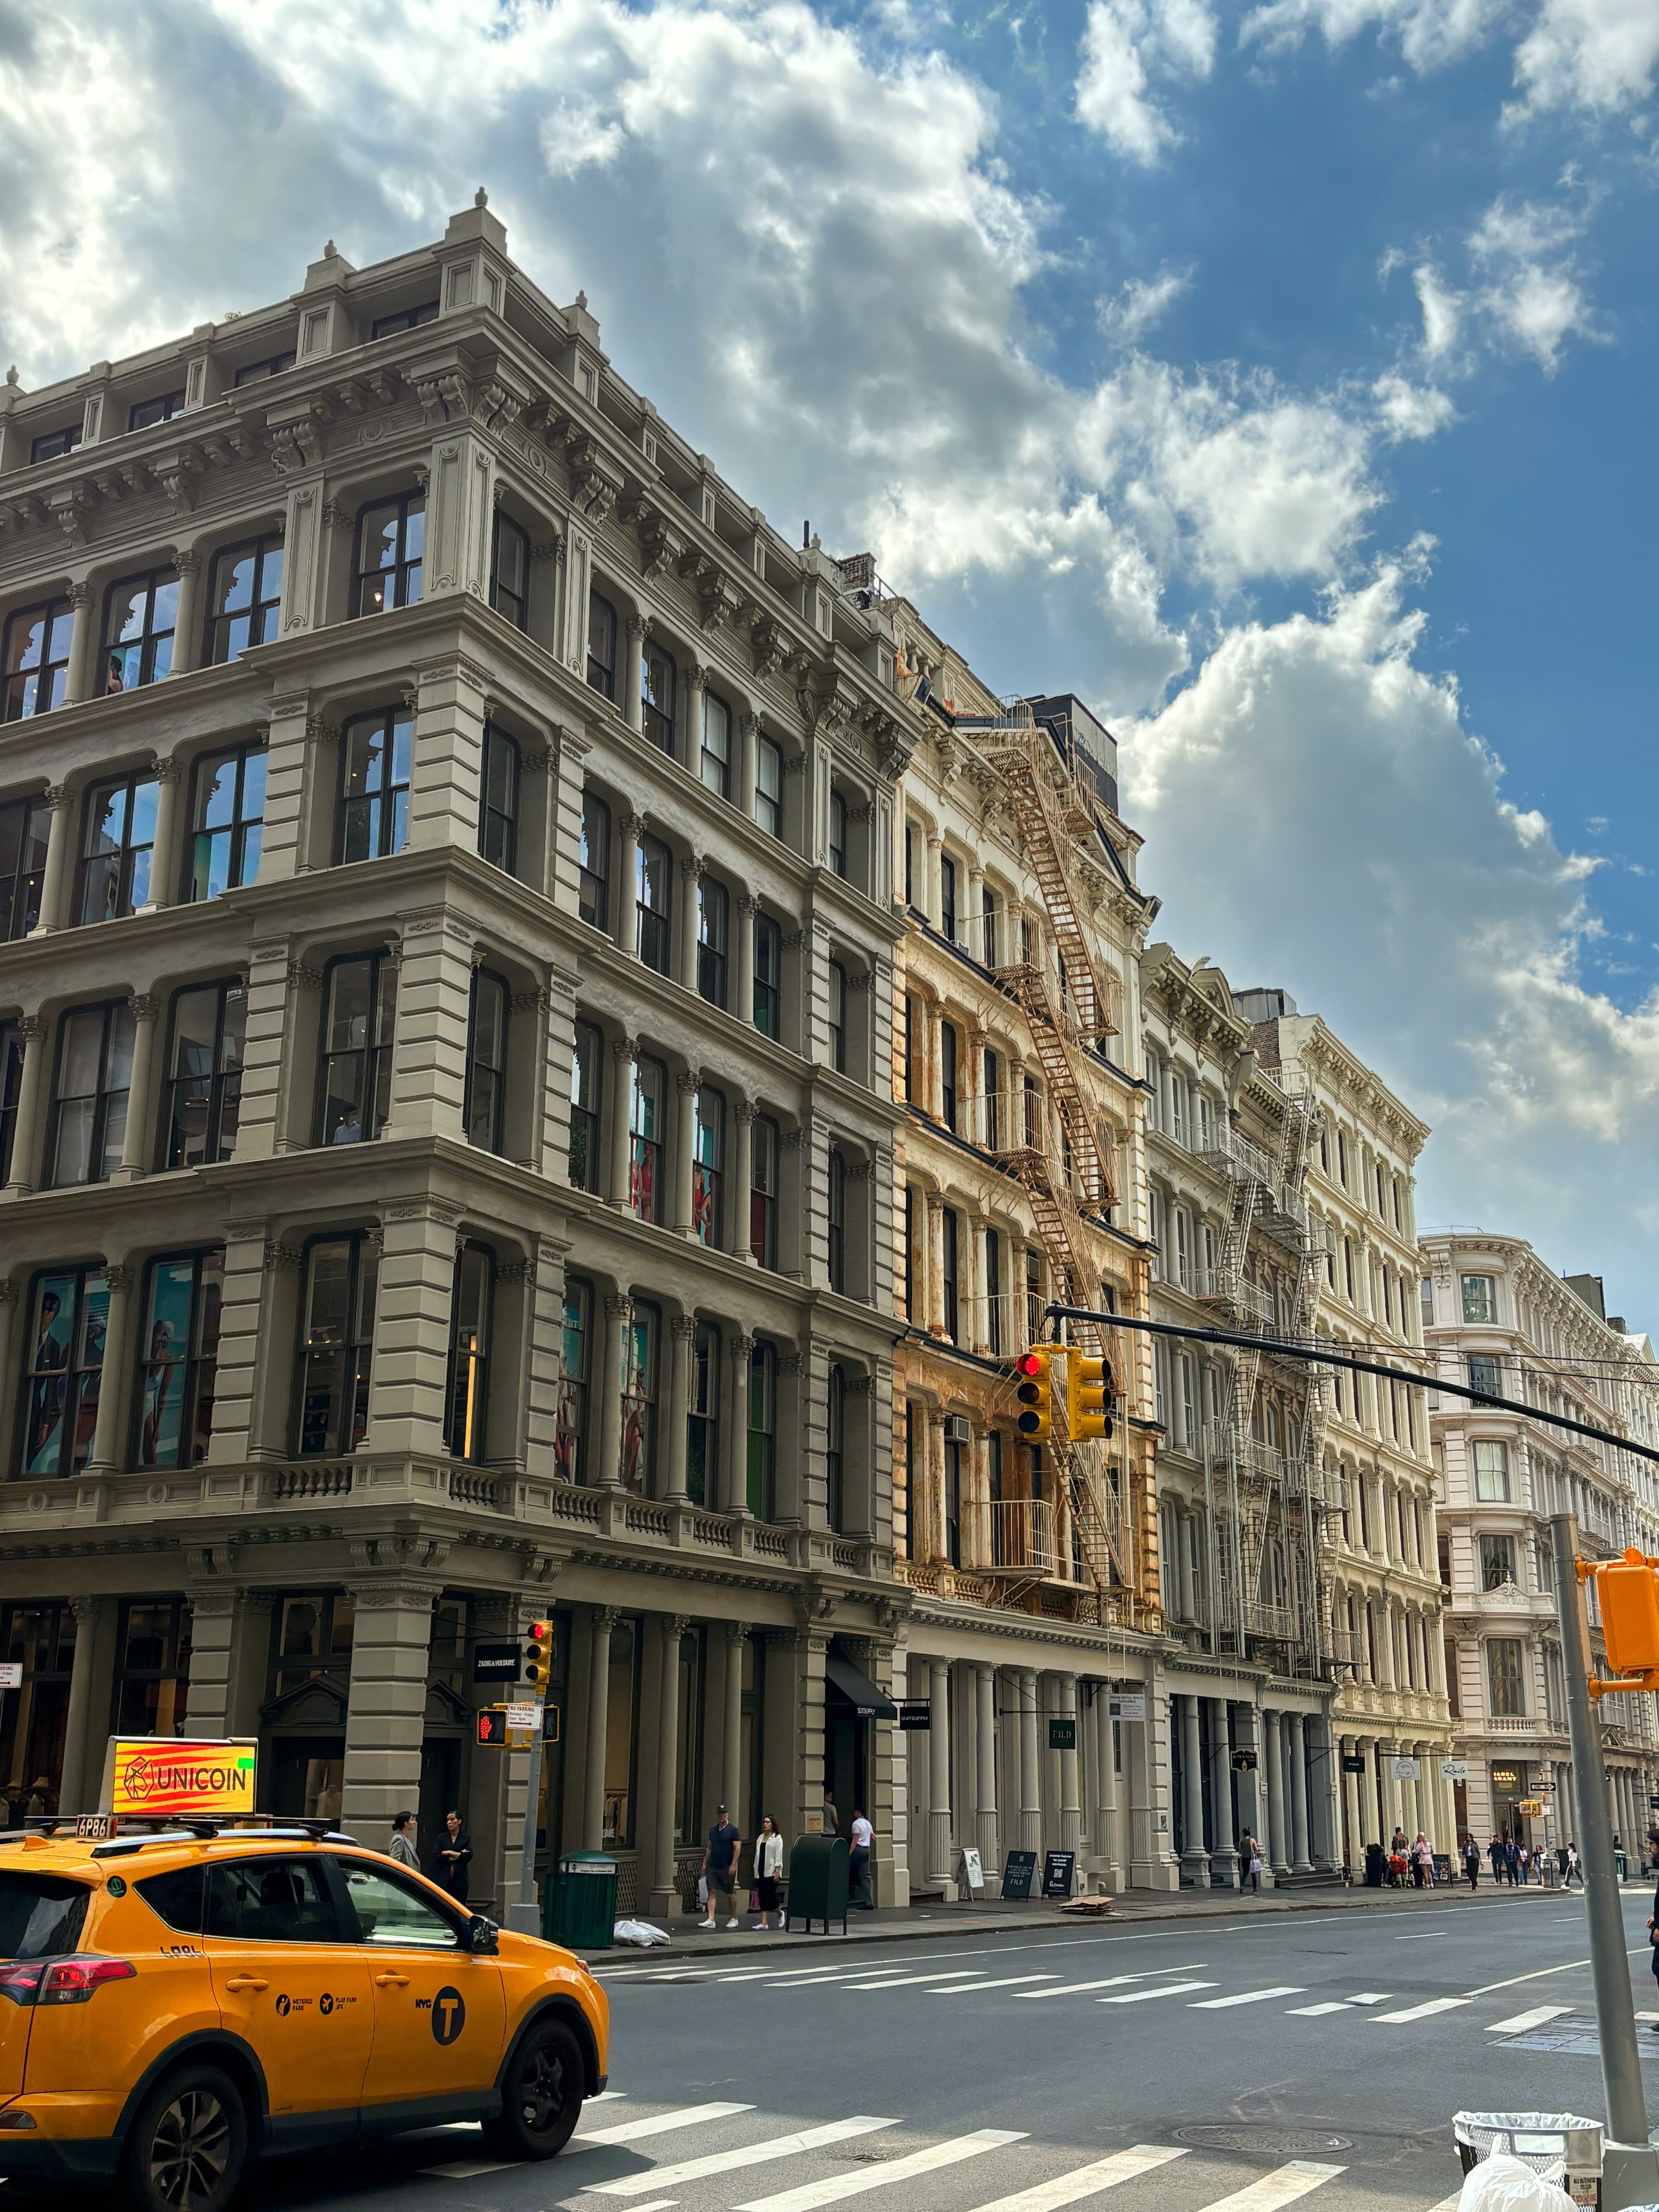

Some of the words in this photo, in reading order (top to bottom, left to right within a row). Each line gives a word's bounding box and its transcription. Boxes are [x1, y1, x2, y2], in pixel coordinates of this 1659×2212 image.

[1053, 1730, 1071, 1738] FILD
[158, 1767, 246, 1791] UNICOIN
[79, 1818, 107, 1837] 6P86
[415, 1999, 431, 2009] NYC
[440, 1999, 458, 2037] T
